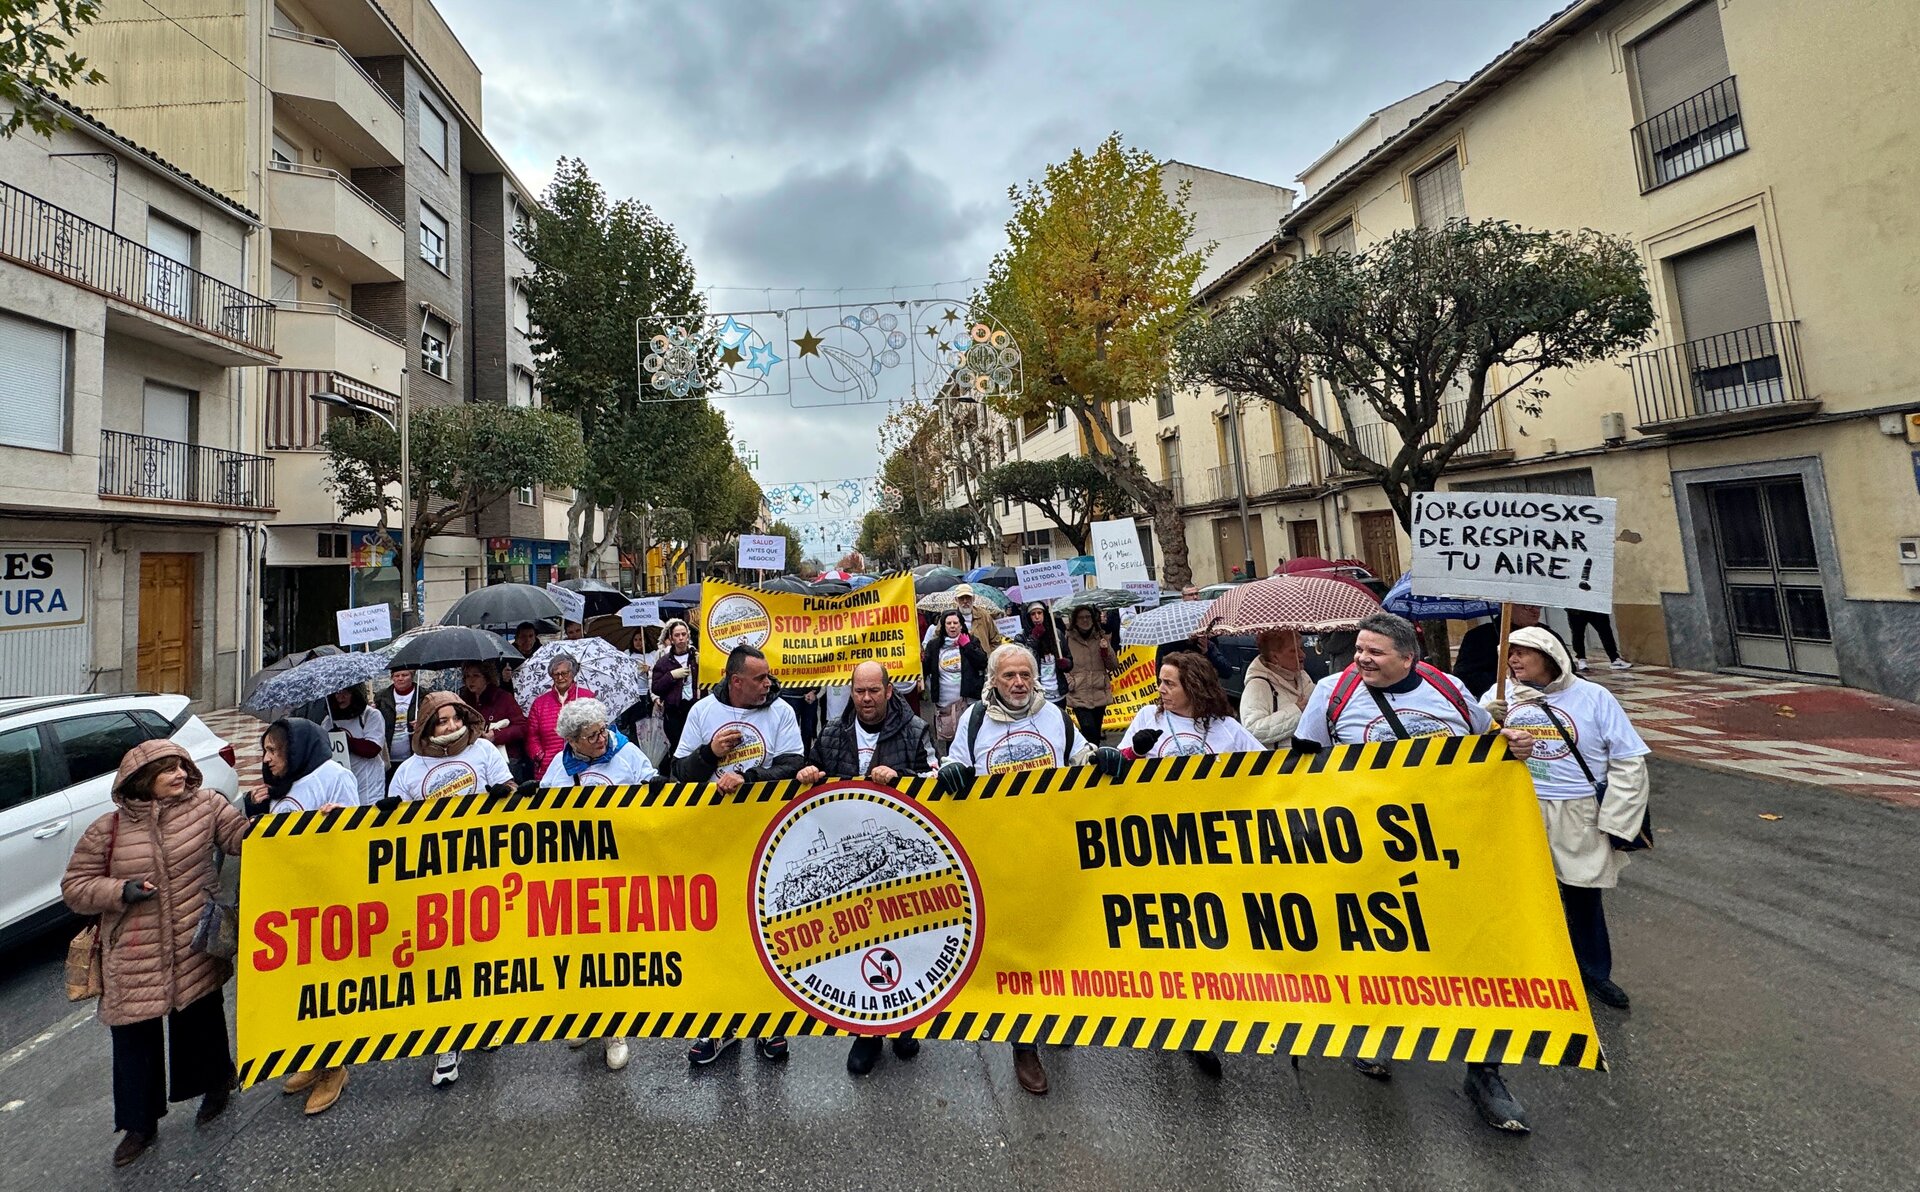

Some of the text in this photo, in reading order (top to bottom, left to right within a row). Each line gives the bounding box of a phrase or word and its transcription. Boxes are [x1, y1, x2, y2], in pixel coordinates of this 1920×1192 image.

[1419, 525, 1588, 552] DE RESPIRAR
[0, 553, 54, 580] ES
[1031, 565, 1052, 574] DINERO
[1437, 551, 1481, 571] TU
[1042, 579, 1067, 587] IMPORTA
[0, 588, 68, 615] URA
[774, 615, 812, 633] STOP
[851, 604, 910, 628] METANO
[782, 629, 904, 649] ALCALA LA REAL Y ALDEAS
[782, 652, 835, 665] BIOMETANO
[850, 648, 874, 660] PERO
[876, 647, 888, 658] NO
[891, 643, 906, 657] ASÍ
[781, 667, 790, 676] DE
[791, 664, 836, 675] PROXIMIDAD
[1119, 659, 1157, 690] METAN
[1139, 681, 1161, 699] ALDE
[1026, 757, 1051, 769] METANO
[1075, 803, 1460, 870] BIOMETANO SI,
[368, 819, 619, 885] PLATAFORMA
[773, 917, 825, 957] STOP
[877, 883, 963, 925] METANO
[1102, 871, 1431, 952] PERO NO ASÍ
[252, 901, 389, 972] STOP
[297, 951, 683, 1021] ALCALA LA REAL Y ALDEAS
[804, 934, 961, 1011] ALCALÁ LA REAL Y ALDEAS
[996, 969, 1580, 1012] POR UN MODELO DE PROXIMIDAD Y AUTOSUFICIENCIA
